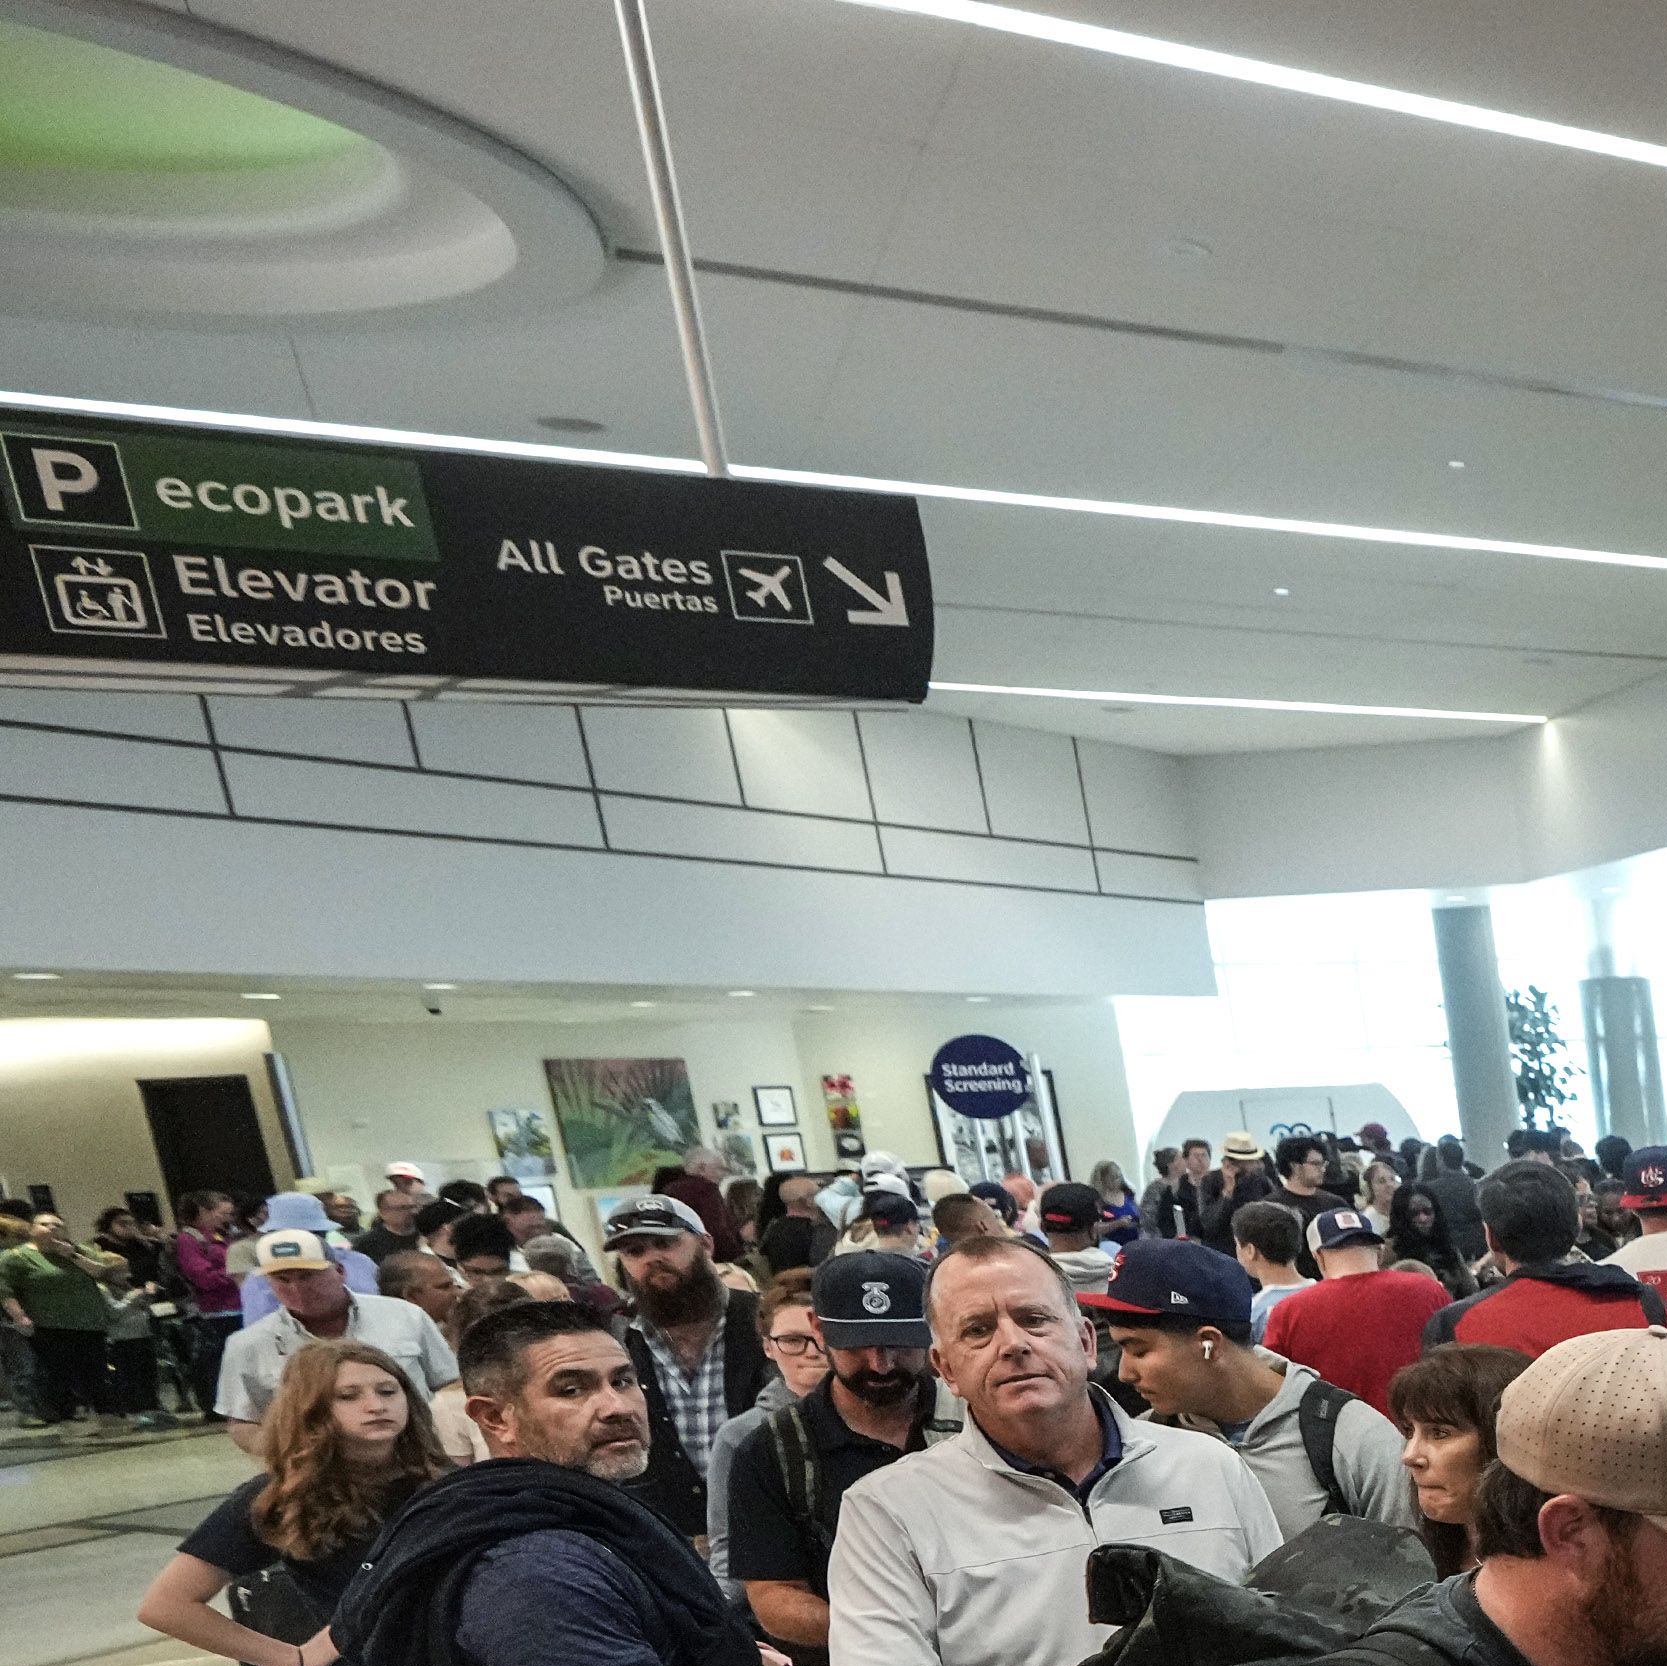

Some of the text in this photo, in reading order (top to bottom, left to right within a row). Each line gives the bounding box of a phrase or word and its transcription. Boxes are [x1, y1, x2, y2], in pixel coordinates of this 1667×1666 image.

[31, 447, 100, 512] P
[155, 476, 416, 530] ecopark
[172, 554, 438, 611] Elevator
[497, 539, 714, 586] All Gates
[603, 584, 720, 614] Puertas
[186, 613, 429, 655] Elevadores
[941, 1061, 1016, 1077] Standard
[944, 1077, 1023, 1094] Screening
